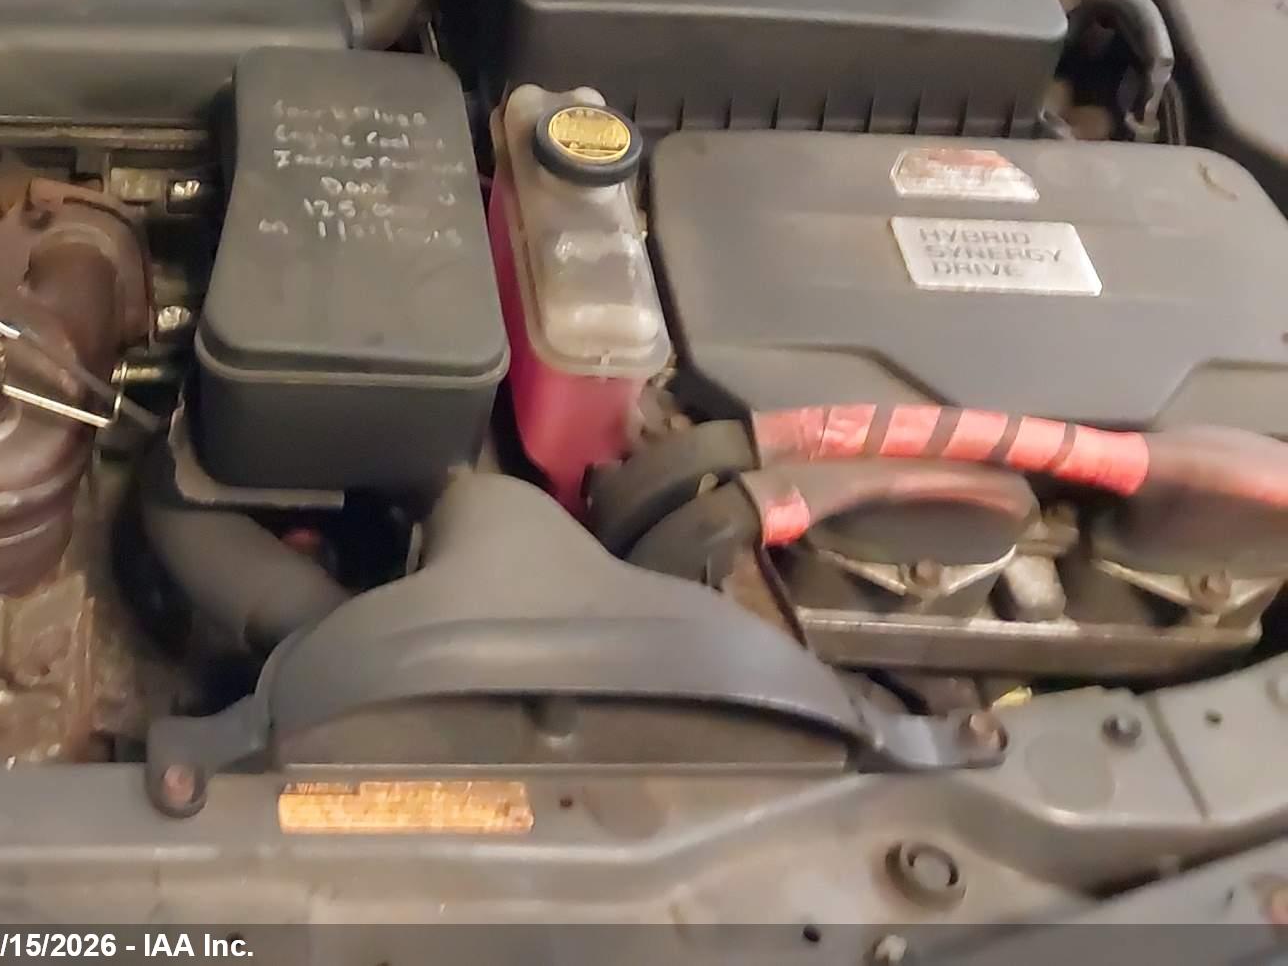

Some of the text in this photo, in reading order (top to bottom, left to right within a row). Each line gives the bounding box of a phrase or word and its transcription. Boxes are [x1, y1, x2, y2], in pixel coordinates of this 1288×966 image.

[919, 228, 1031, 245] HYBRID
[925, 245, 1062, 263] SYNERGY
[932, 261, 1025, 277] DRIVE
